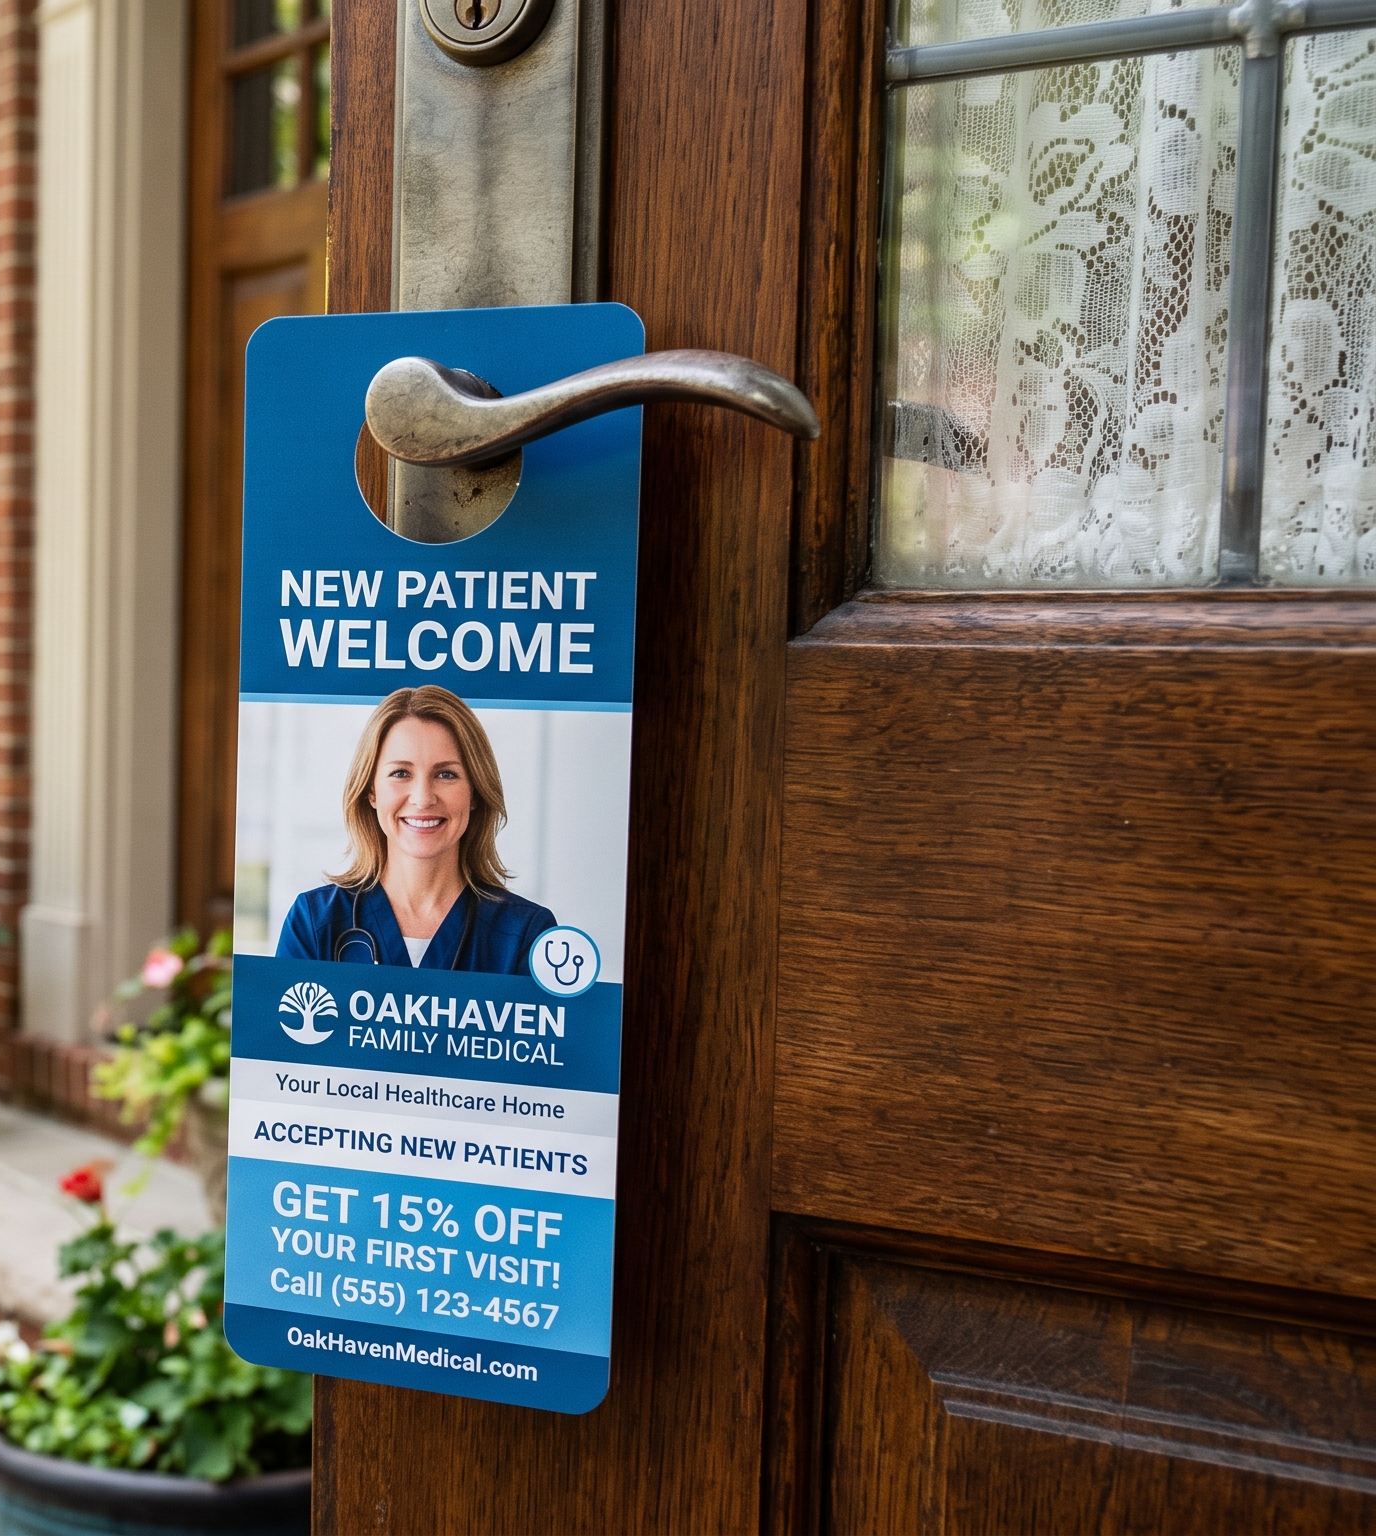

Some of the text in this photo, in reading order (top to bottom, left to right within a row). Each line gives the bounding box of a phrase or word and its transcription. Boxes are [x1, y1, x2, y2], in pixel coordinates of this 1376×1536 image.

[281, 570, 597, 610] NEW PATIENT
[280, 618, 595, 674] WELCOME
[349, 990, 566, 1038] OAKHAVEN
[349, 1026, 564, 1066] FAMILY MEDICAL
[276, 1073, 565, 1119] Your Local Healthcare Home
[254, 1121, 588, 1176] ACCEPTING NEW PATIENTS
[272, 1181, 563, 1249] GET 15% OFF
[271, 1226, 561, 1290] YOUR FIRST VISIT!
[270, 1267, 560, 1330] Call (555) 123-4567
[287, 1326, 538, 1381] OakHavenMedical.com
